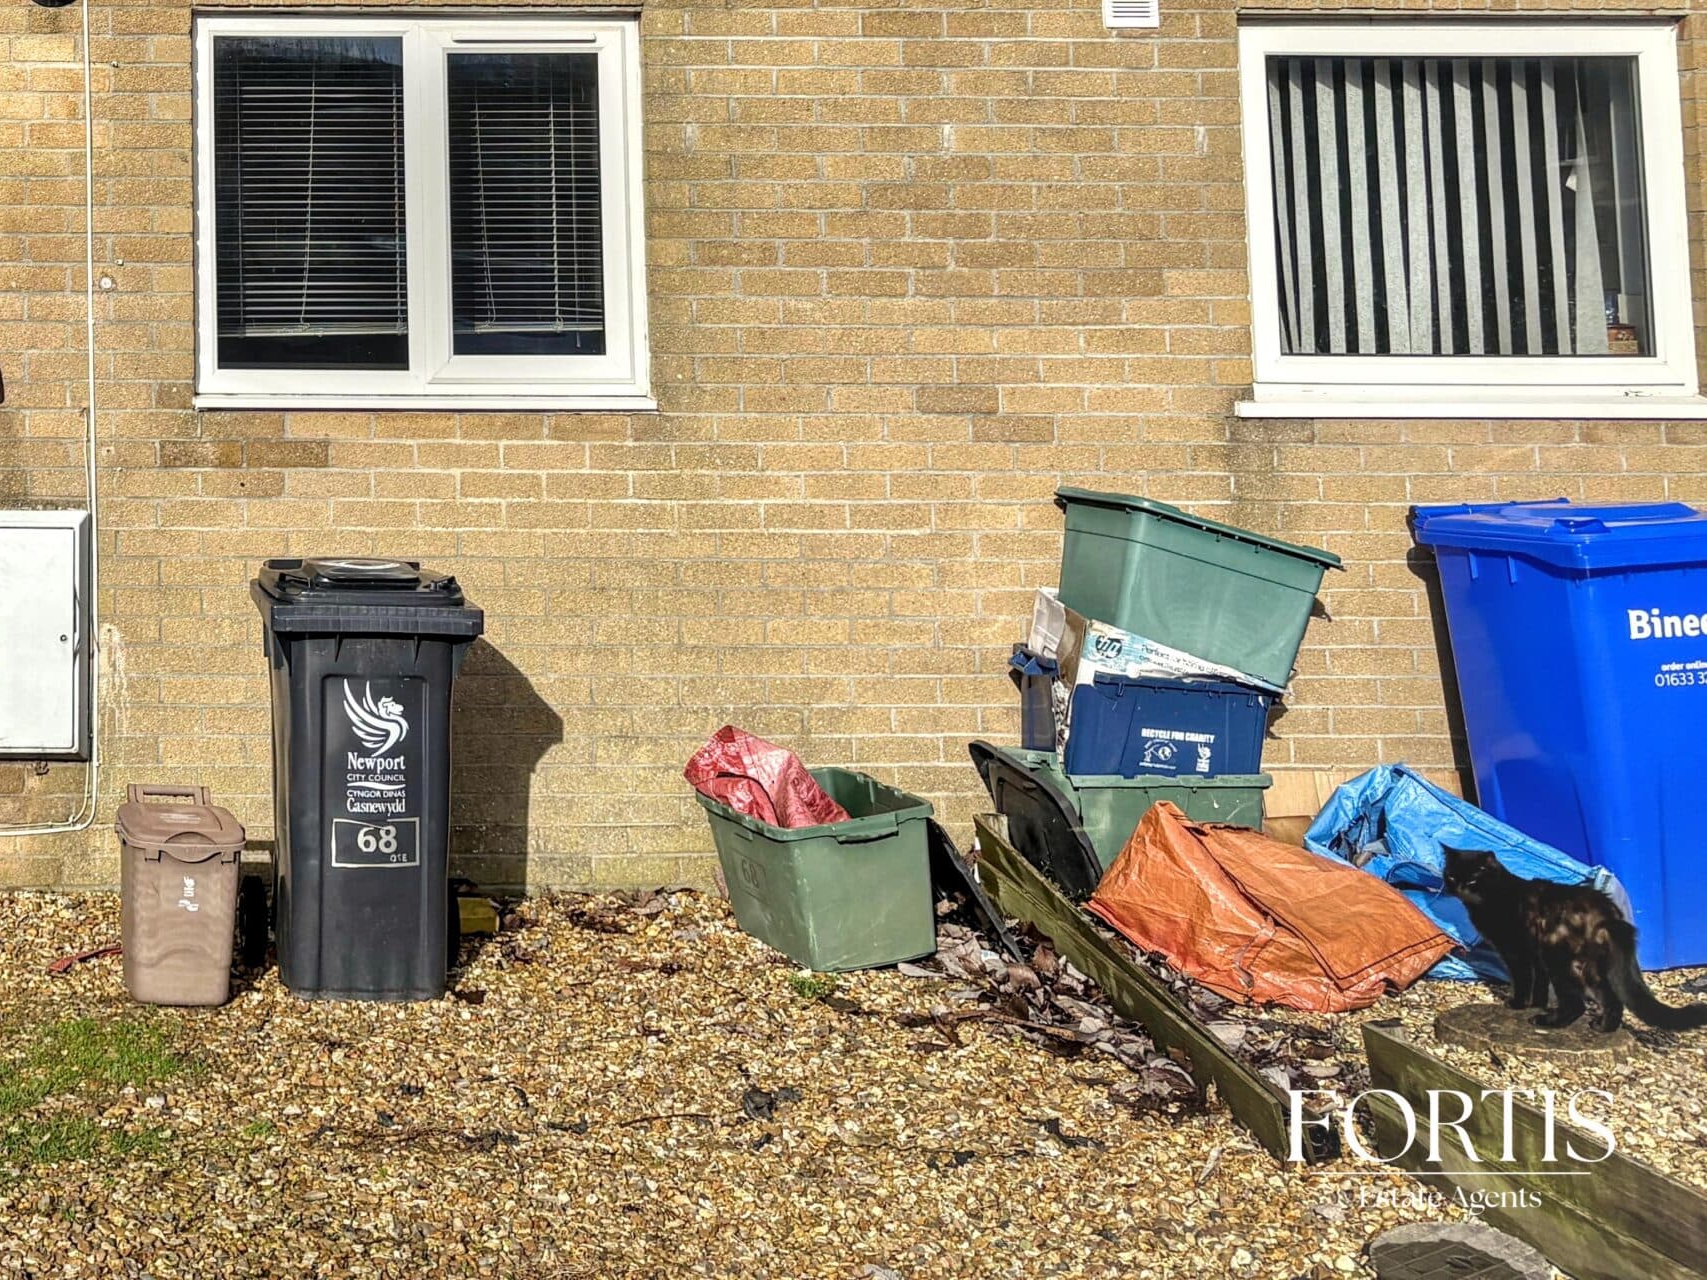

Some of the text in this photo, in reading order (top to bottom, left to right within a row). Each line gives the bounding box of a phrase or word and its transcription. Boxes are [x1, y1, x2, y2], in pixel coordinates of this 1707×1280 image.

[1654, 672, 1695, 687] 01633
[1141, 727, 1215, 744] RECYCLE FOR CHARITY
[347, 751, 406, 774] Newport
[346, 773, 406, 782] CITY COUNCIL
[346, 789, 406, 798] CYNGOR DINAS
[346, 797, 406, 816] Casnewydd
[357, 825, 398, 854] 68
